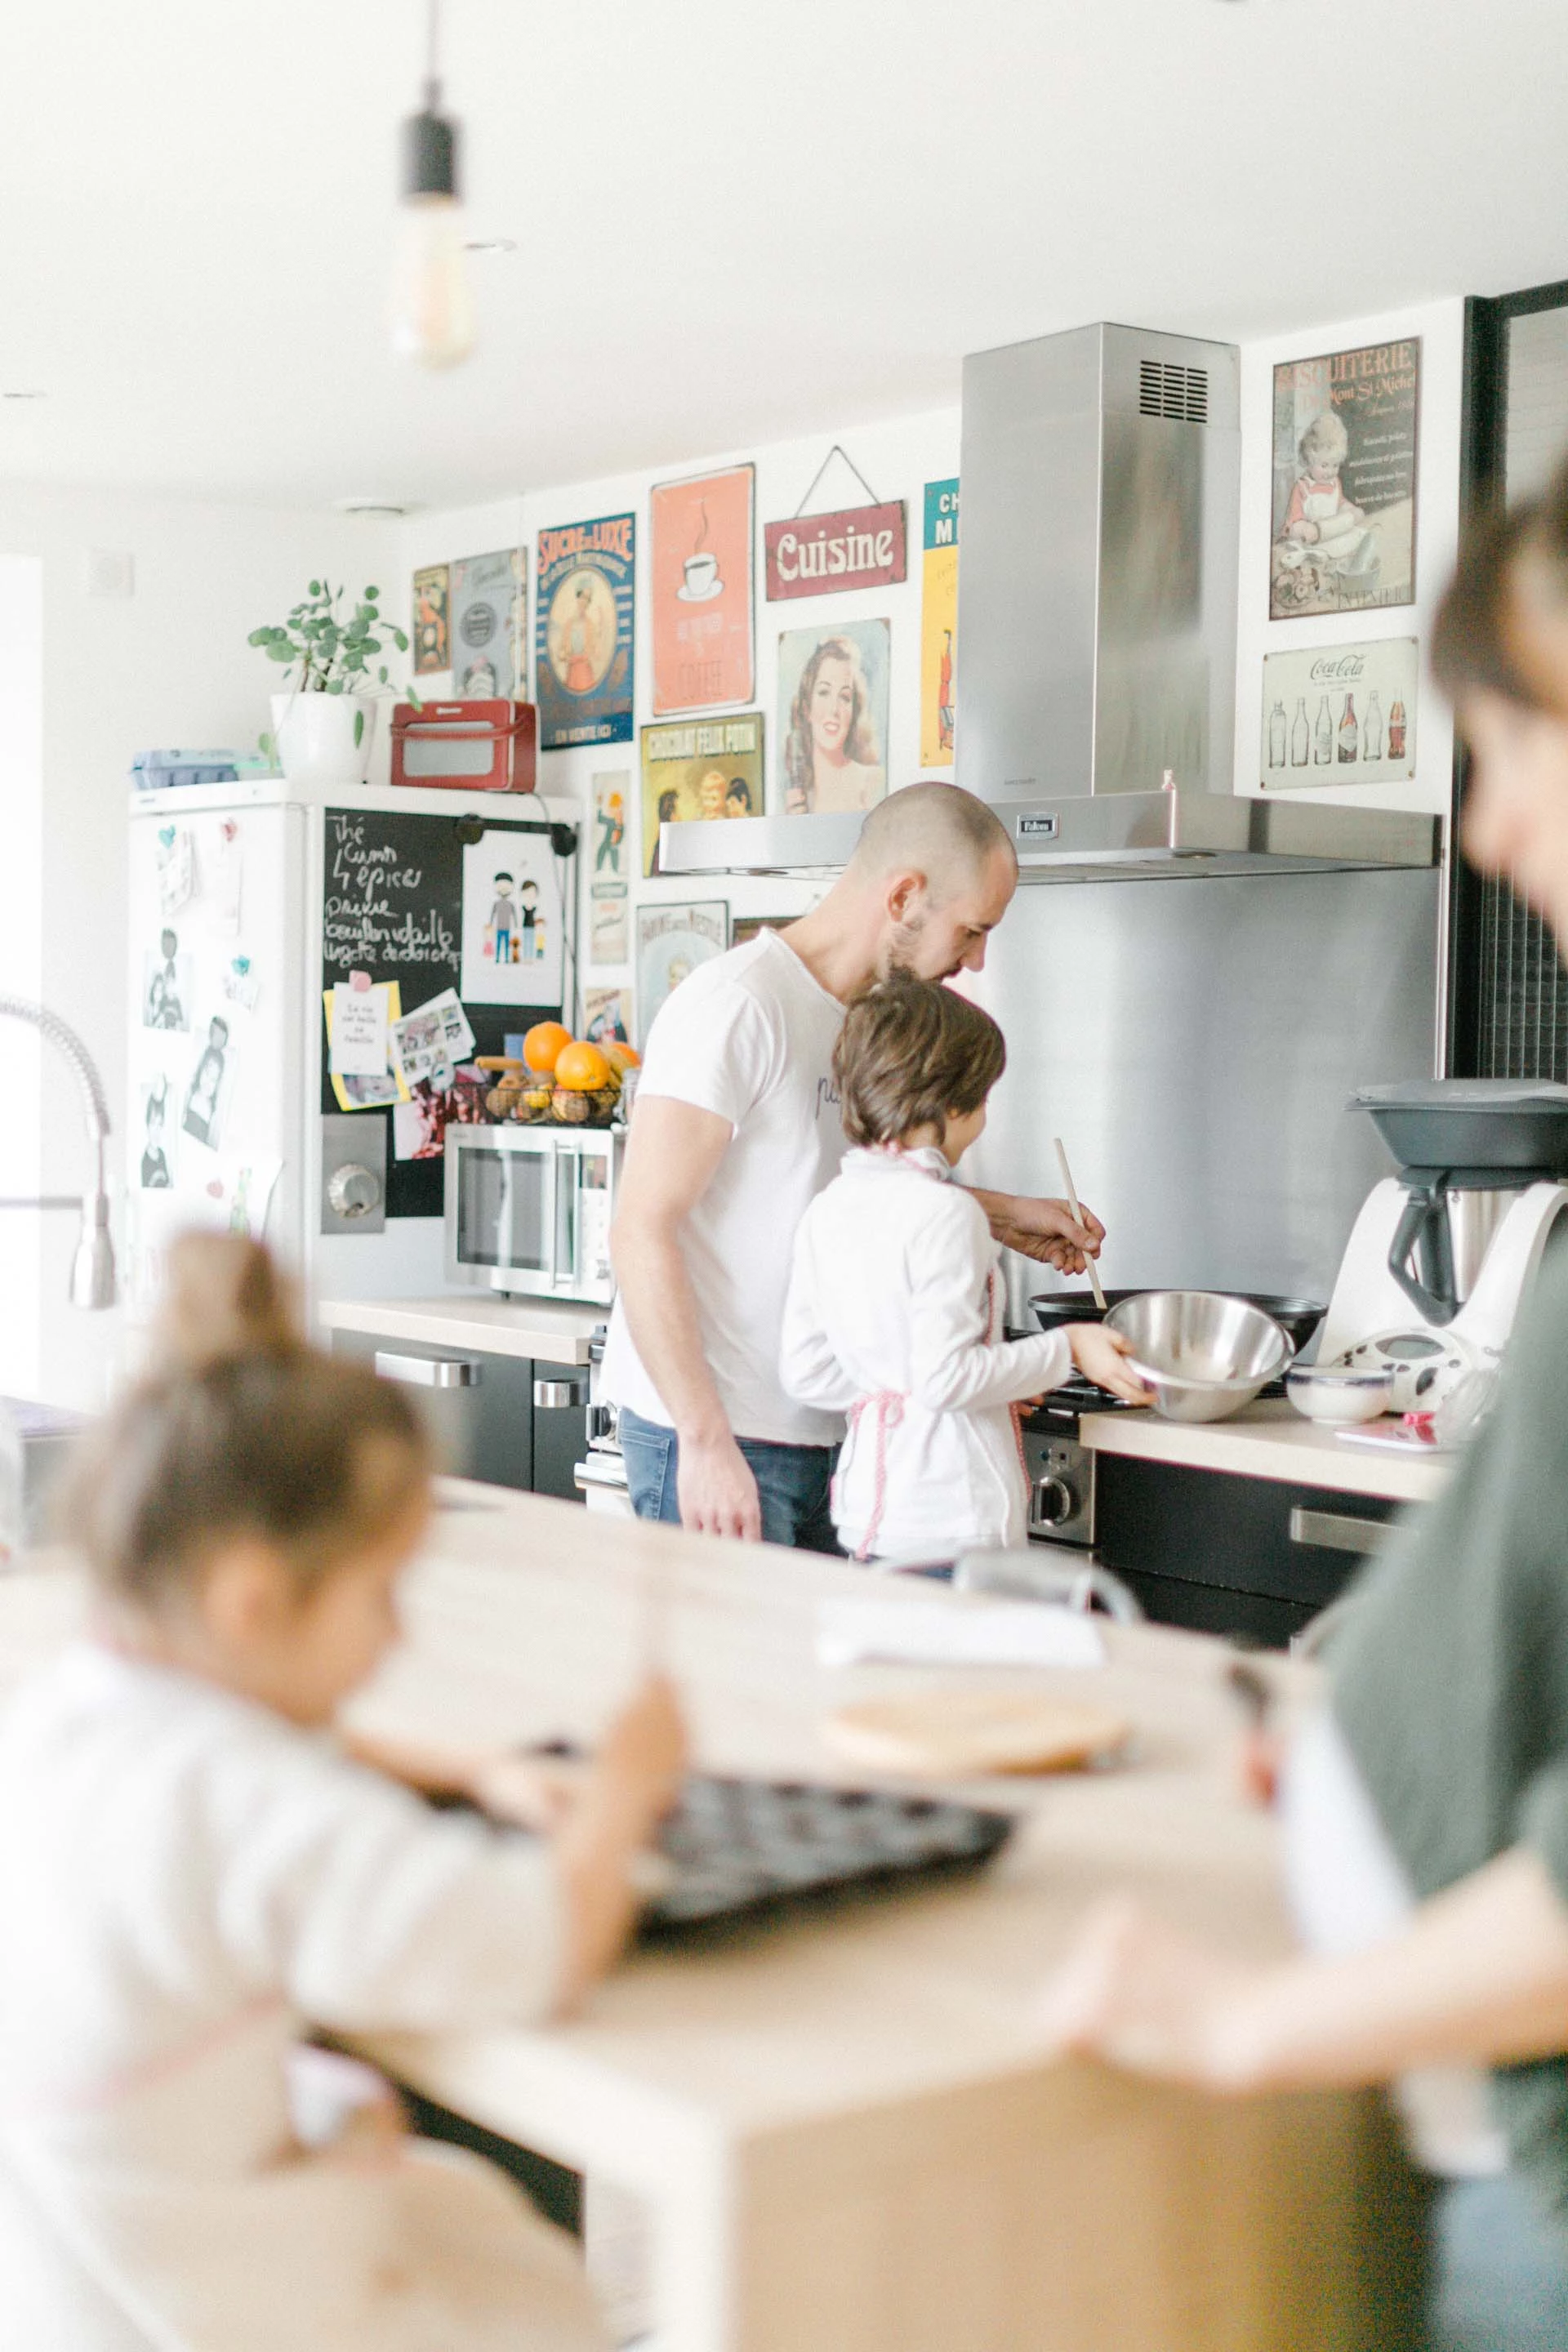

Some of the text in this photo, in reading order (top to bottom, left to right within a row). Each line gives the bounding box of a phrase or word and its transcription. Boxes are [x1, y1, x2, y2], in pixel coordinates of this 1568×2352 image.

[537, 526, 585, 575] SUCRE
[593, 518, 631, 562] LUXE
[777, 525, 893, 581] Cuisine
